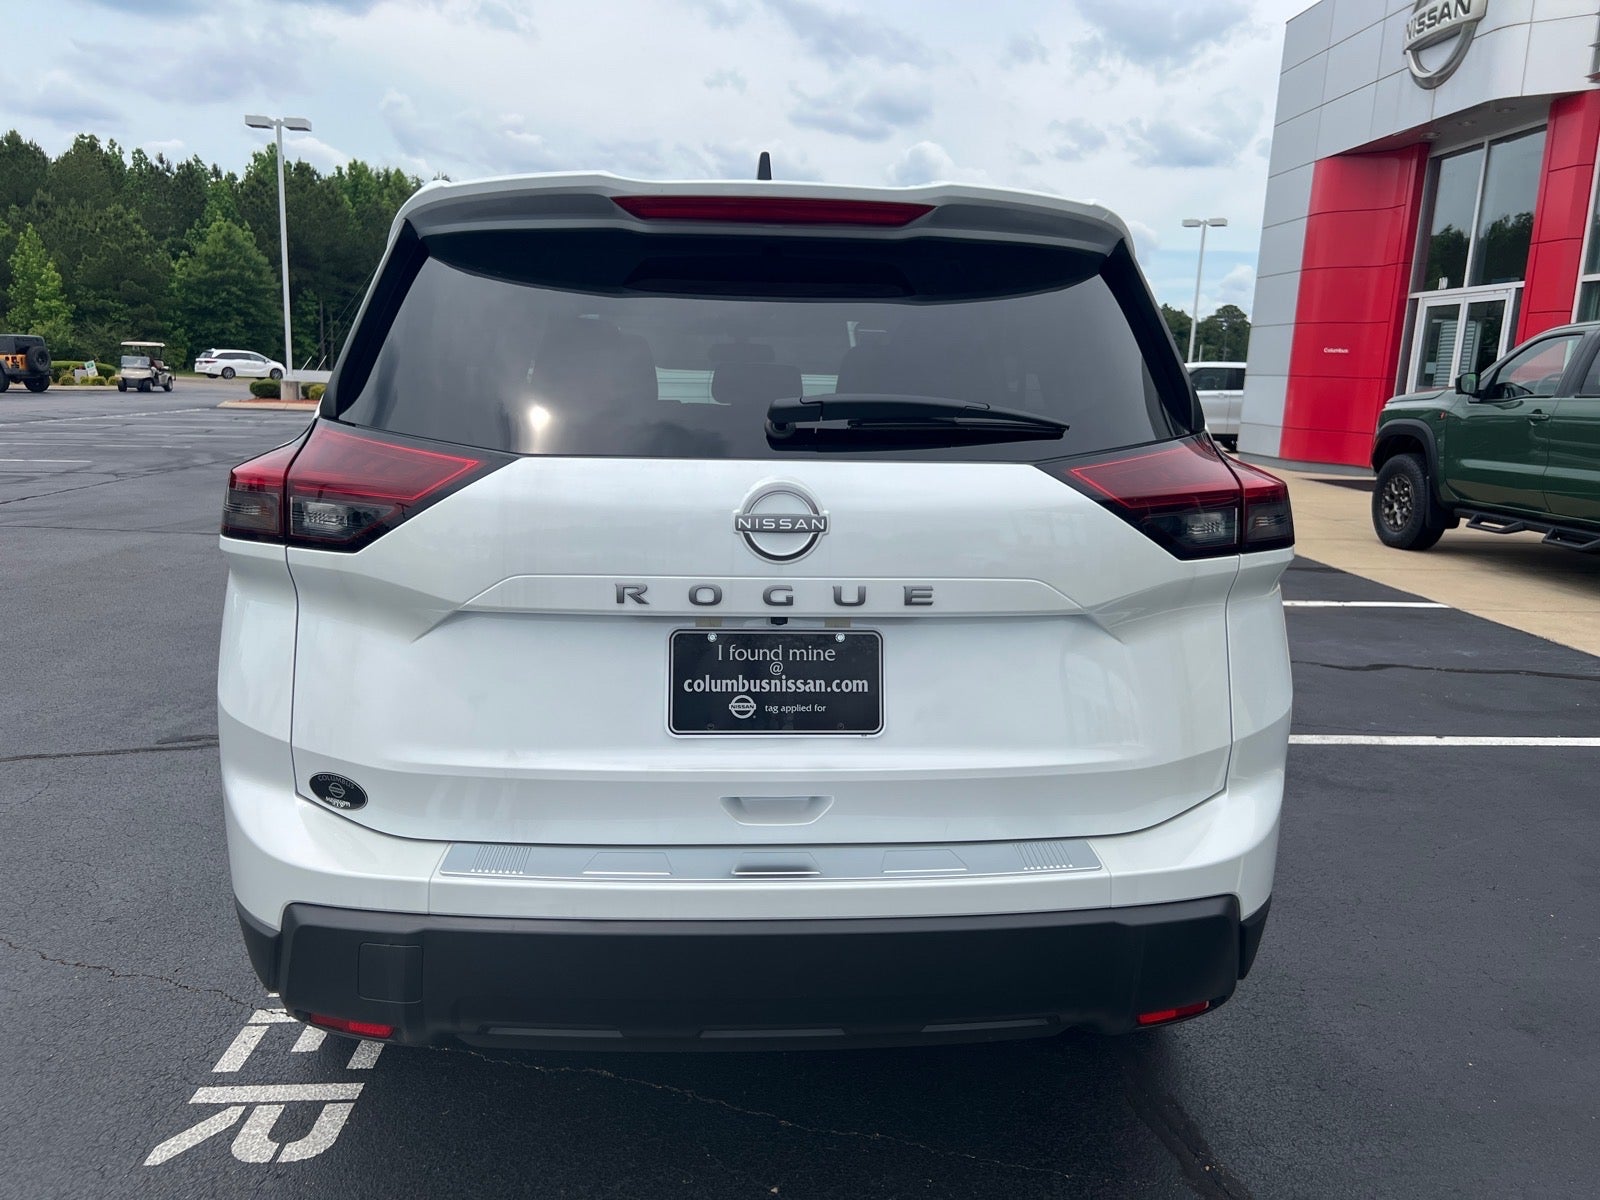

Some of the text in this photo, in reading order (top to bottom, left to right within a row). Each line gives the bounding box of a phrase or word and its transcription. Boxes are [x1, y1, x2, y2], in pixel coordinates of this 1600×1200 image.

[1406, 0, 1472, 40] NISSAN
[738, 518, 825, 530] NISSAN
[614, 582, 935, 607] ROGUE
[717, 644, 836, 661] I found mine
[769, 661, 784, 676] @
[683, 674, 869, 693] columbusnissan.com
[764, 703, 827, 714] tag applied for
